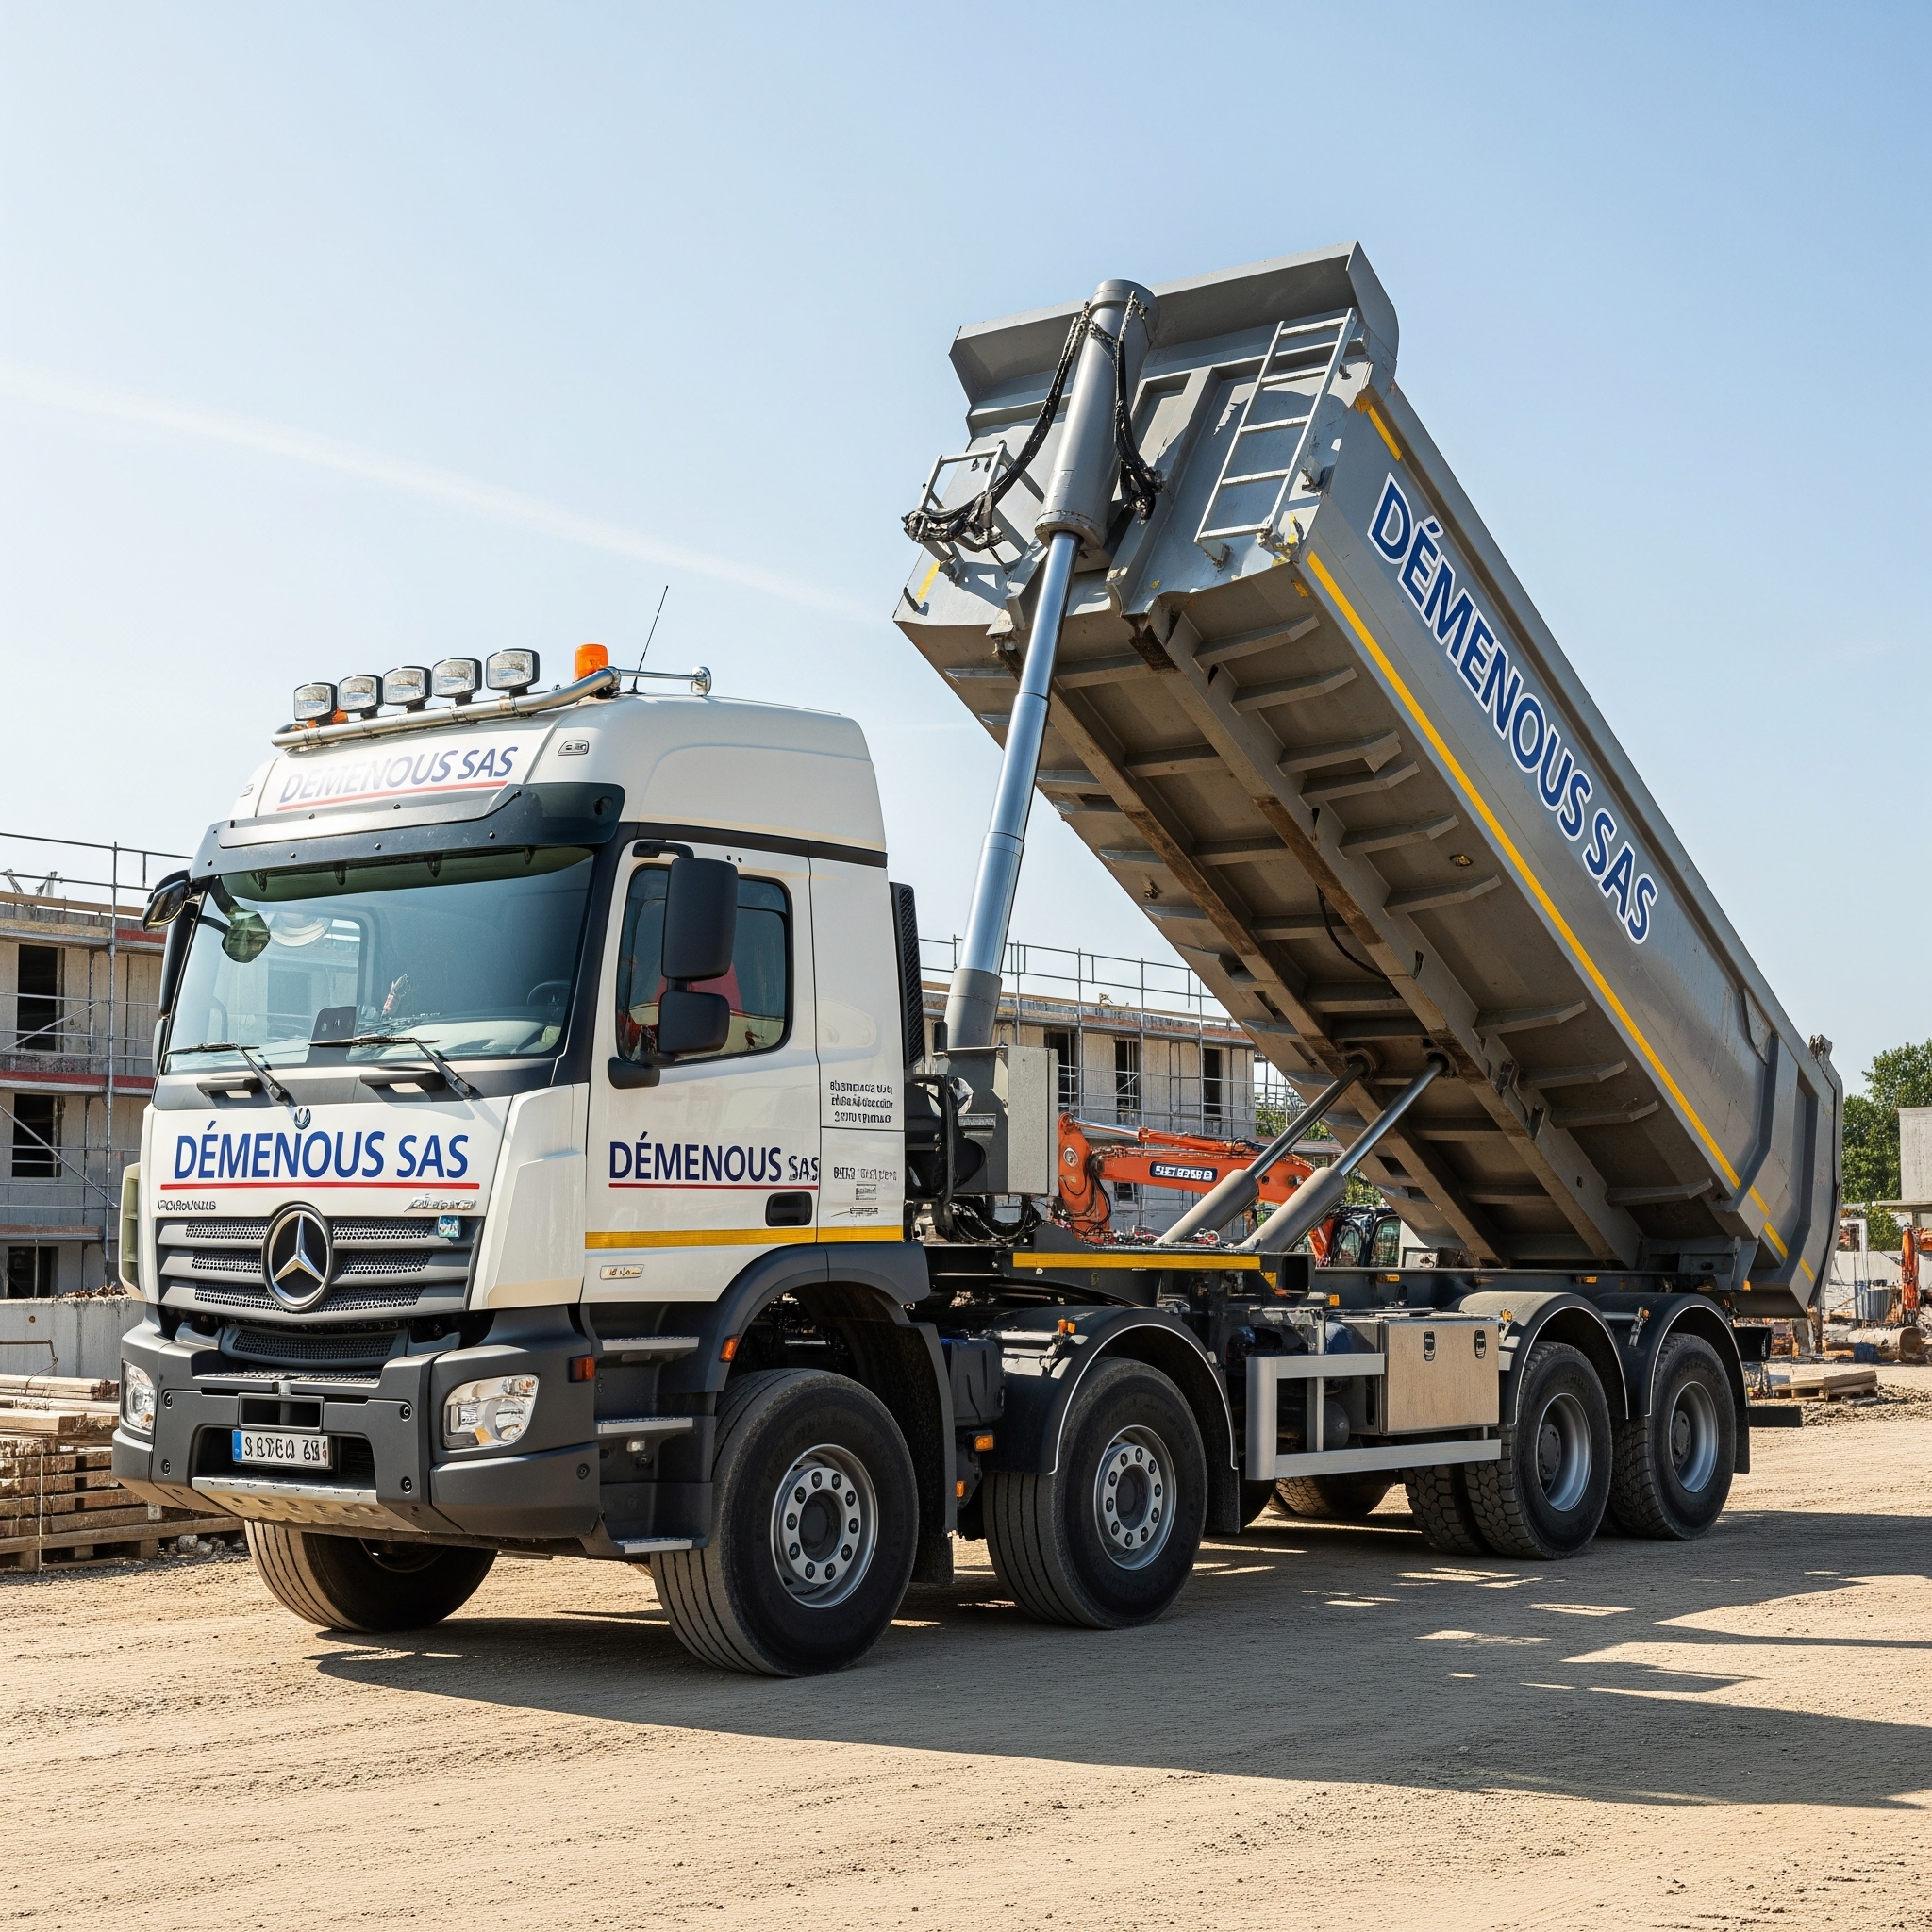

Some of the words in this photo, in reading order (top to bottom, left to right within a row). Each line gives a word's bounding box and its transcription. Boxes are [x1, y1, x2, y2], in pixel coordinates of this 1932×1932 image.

[1367, 472, 1593, 841] DÉMENOUS
[1581, 808, 1658, 944] SAS
[457, 746, 519, 780] SAS
[175, 1120, 385, 1179] DÉMENOUS
[396, 1133, 470, 1179] SAS
[608, 1130, 782, 1181] DÉMENOUS
[788, 1156, 819, 1181] SAS
